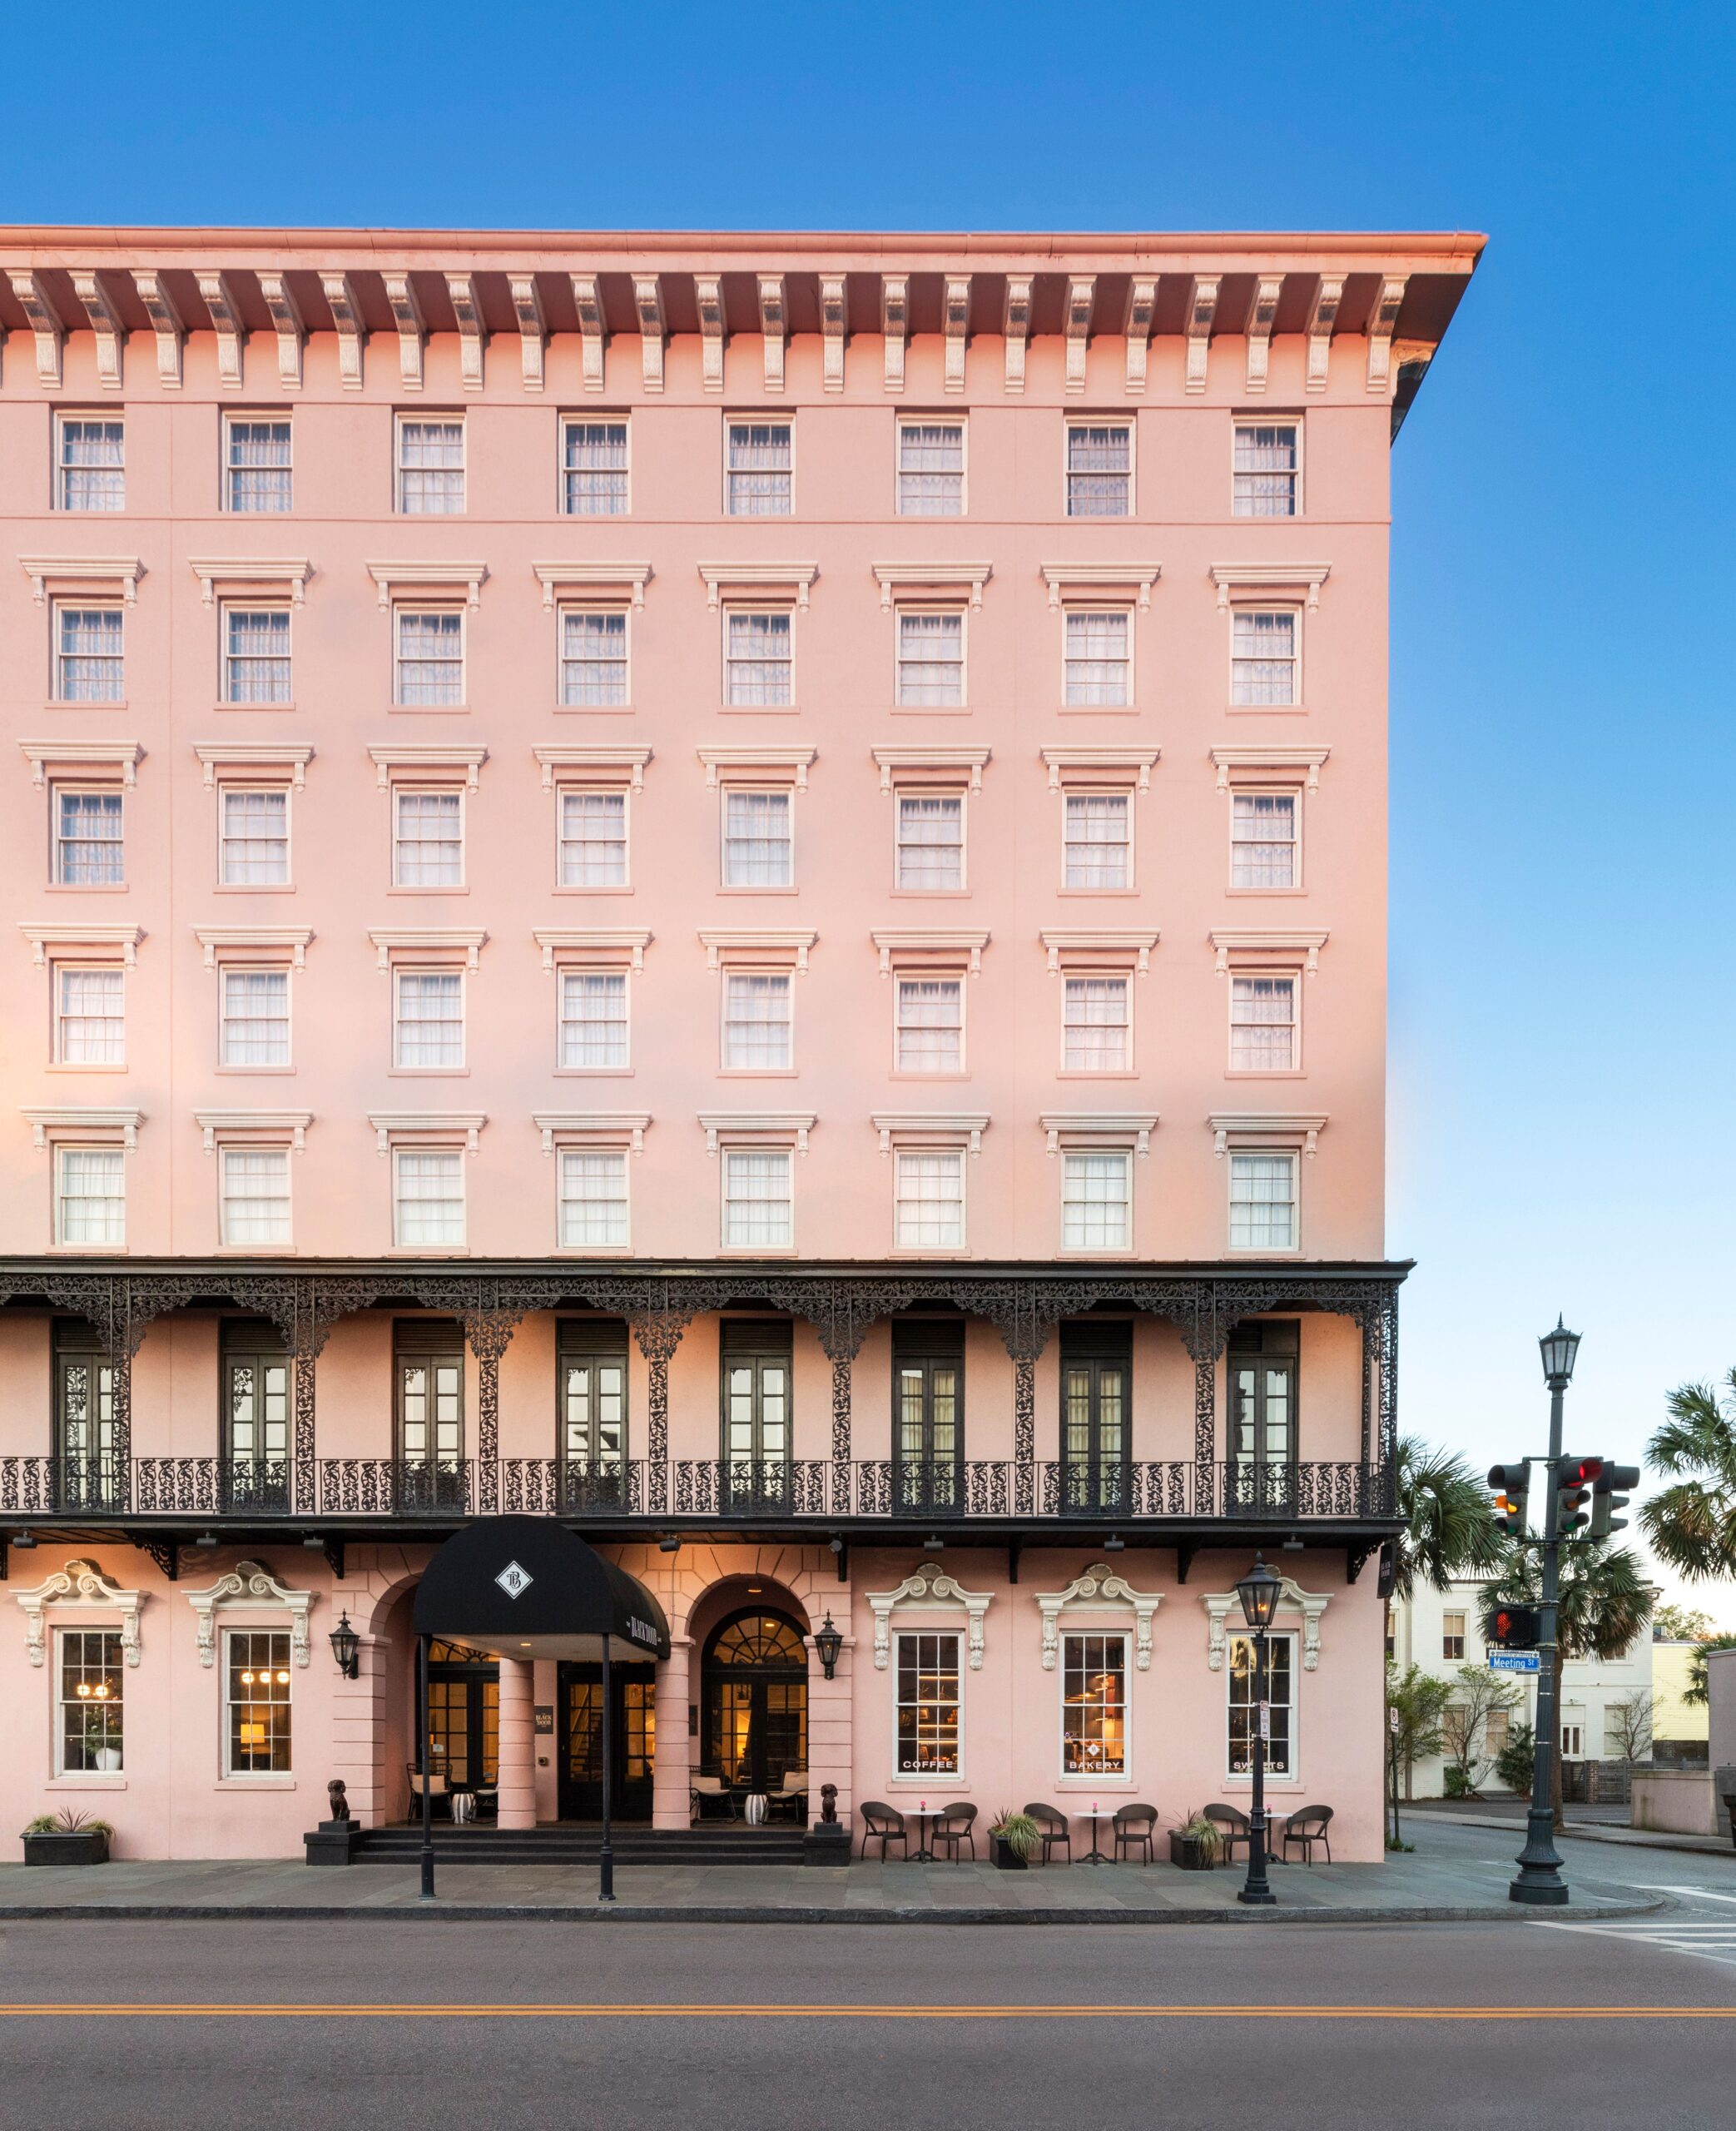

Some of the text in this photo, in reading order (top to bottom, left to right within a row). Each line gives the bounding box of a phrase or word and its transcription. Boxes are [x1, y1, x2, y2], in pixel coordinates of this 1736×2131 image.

[1493, 1657, 1525, 1669] Meeting
[903, 1761, 953, 1769] COFFEE
[1069, 1761, 1120, 1770] BAKERY
[1233, 1761, 1284, 1770] SWETS
